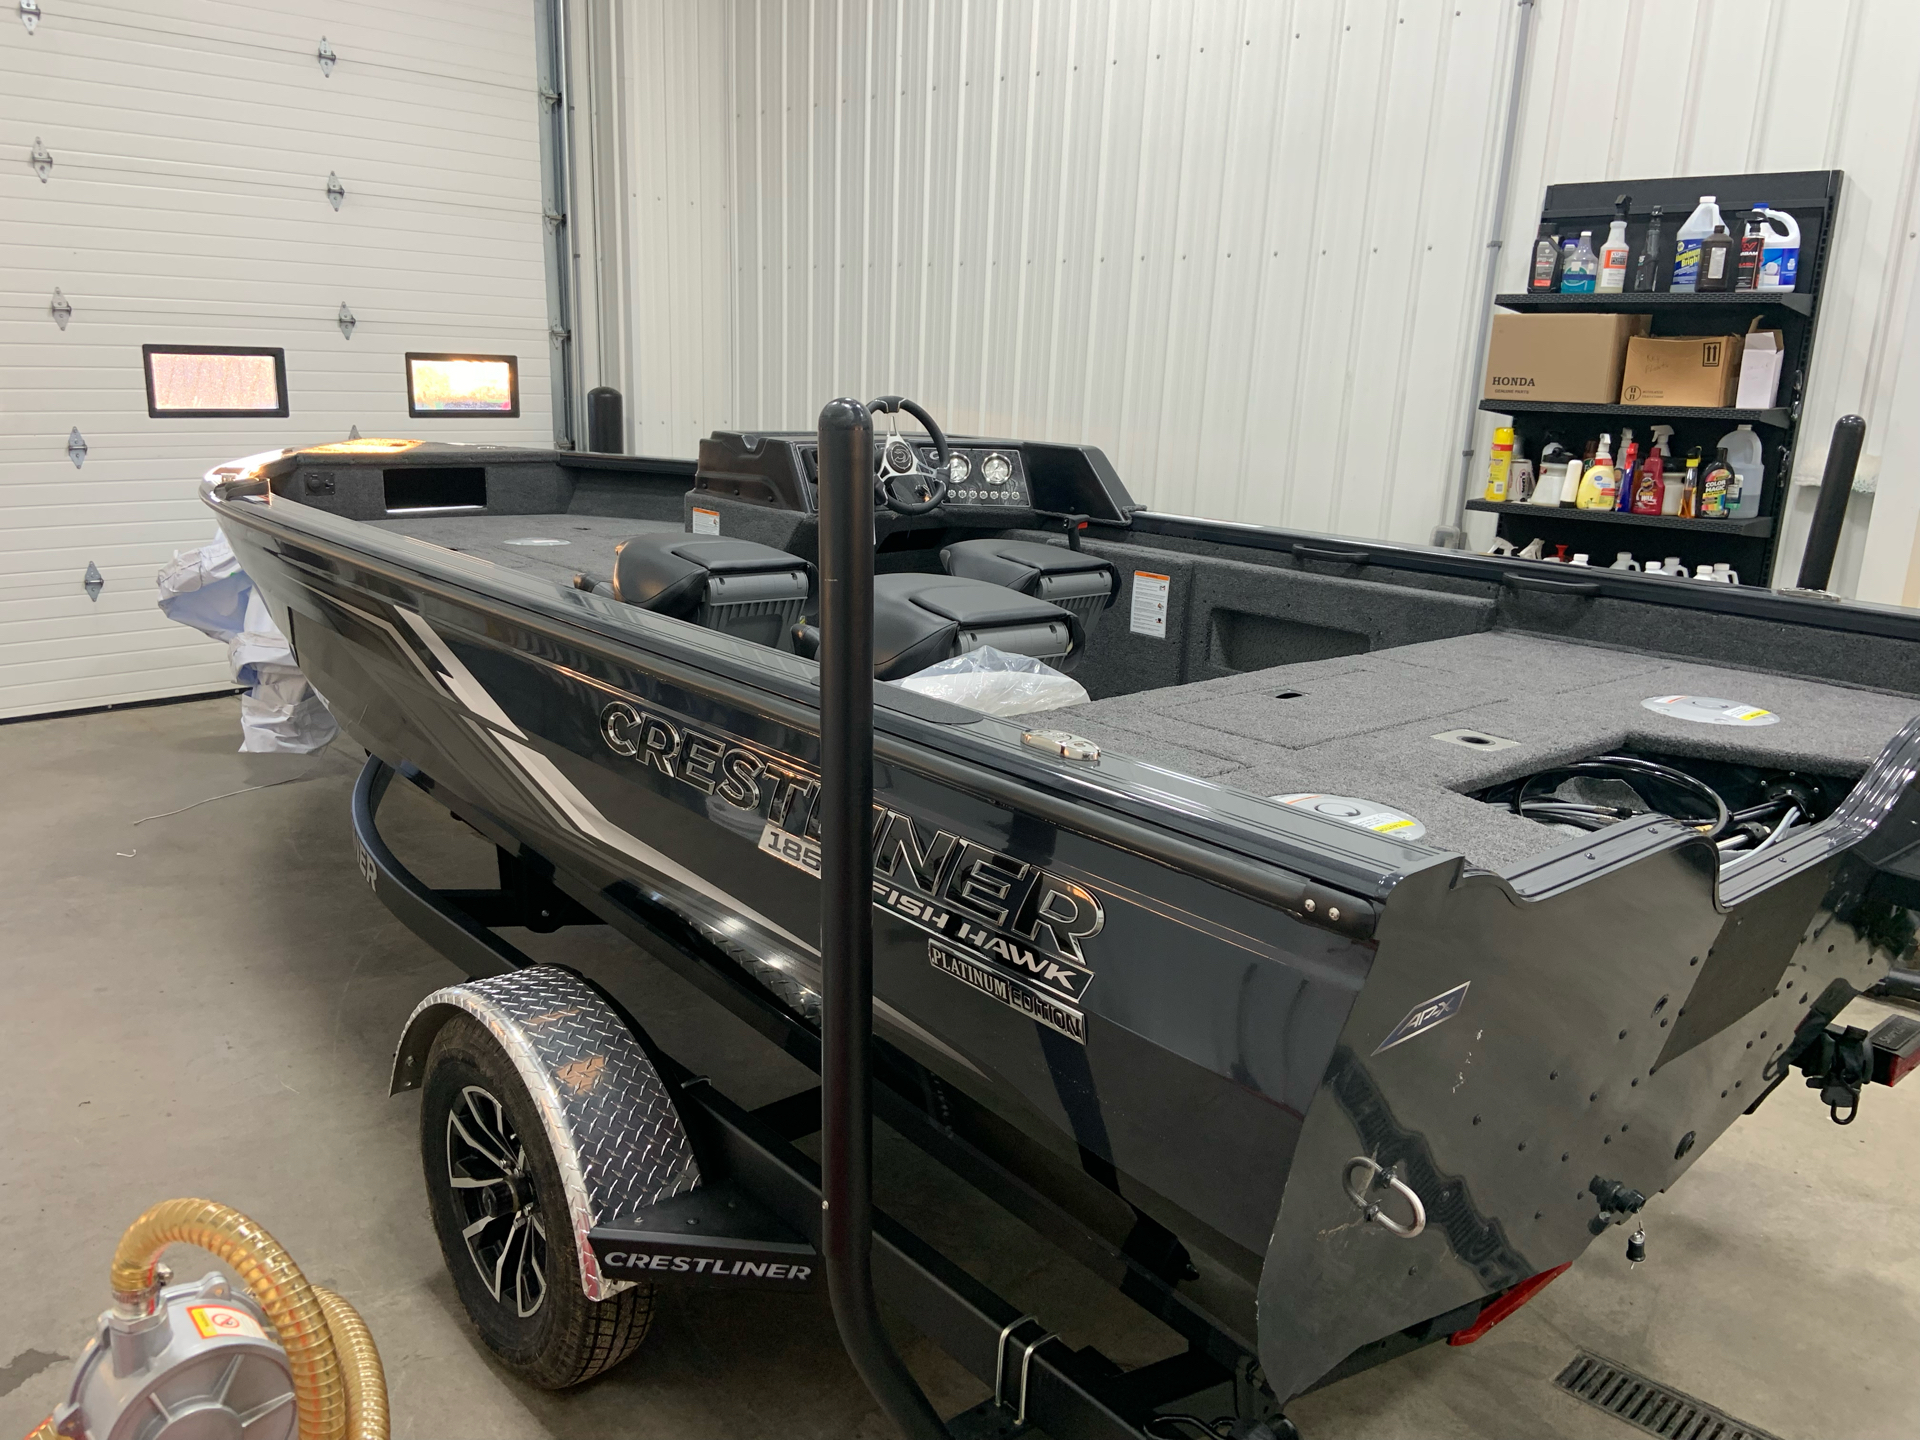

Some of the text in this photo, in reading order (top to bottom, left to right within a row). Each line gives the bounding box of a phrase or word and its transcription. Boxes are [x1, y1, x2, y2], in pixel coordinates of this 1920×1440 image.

[1492, 376, 1536, 387] HONDA
[1705, 485, 1725, 493] MAGIC
[957, 922, 1077, 991] HAWK
[931, 946, 1083, 1040] PLATINUM EDITION
[604, 1251, 812, 1281] CRESTLINER
